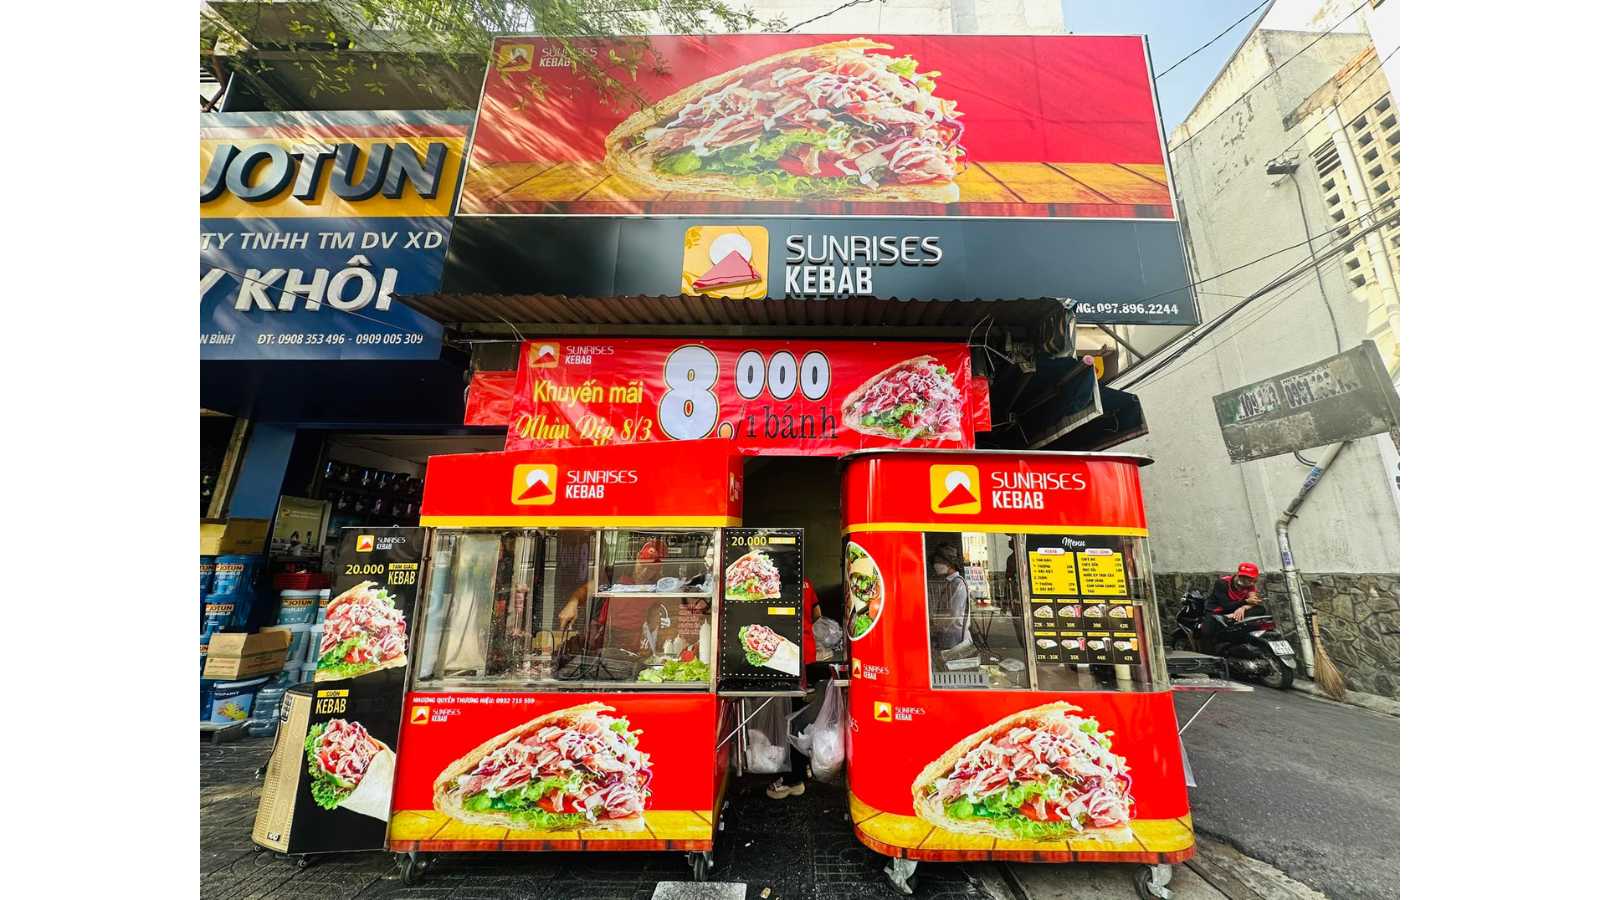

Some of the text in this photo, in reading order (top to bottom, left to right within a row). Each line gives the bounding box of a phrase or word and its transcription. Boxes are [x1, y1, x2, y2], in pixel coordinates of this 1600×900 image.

[200, 143, 448, 202] JOTUN
[200, 230, 444, 250] TY TNHH TM DV XD
[785, 234, 943, 265] SUNRISES
[234, 254, 399, 312] KHÔI
[784, 265, 873, 295] KEBAB
[1097, 302, 1179, 315] 097.896.2244
[257, 333, 275, 345] ĐT:
[278, 333, 304, 345] 0908
[305, 333, 324, 345] 353
[325, 333, 345, 345] 496
[355, 333, 381, 345] 0909
[383, 333, 402, 345] 005
[566, 345, 615, 355] SUNRISES
[564, 355, 592, 365] KEBAB
[533, 379, 644, 408] Khuyến mãi
[620, 415, 653, 443] 8/3
[566, 469, 639, 485] SUNRISES
[991, 471, 1086, 490] SUNRISES
[565, 484, 605, 499] KEBAB
[991, 490, 1044, 510] KEBAB
[731, 536, 767, 546] 20.000
[1061, 536, 1086, 549] Menu
[344, 563, 385, 576] 20.000
[388, 570, 416, 585] KEBAB
[315, 698, 347, 715] KEBAB
